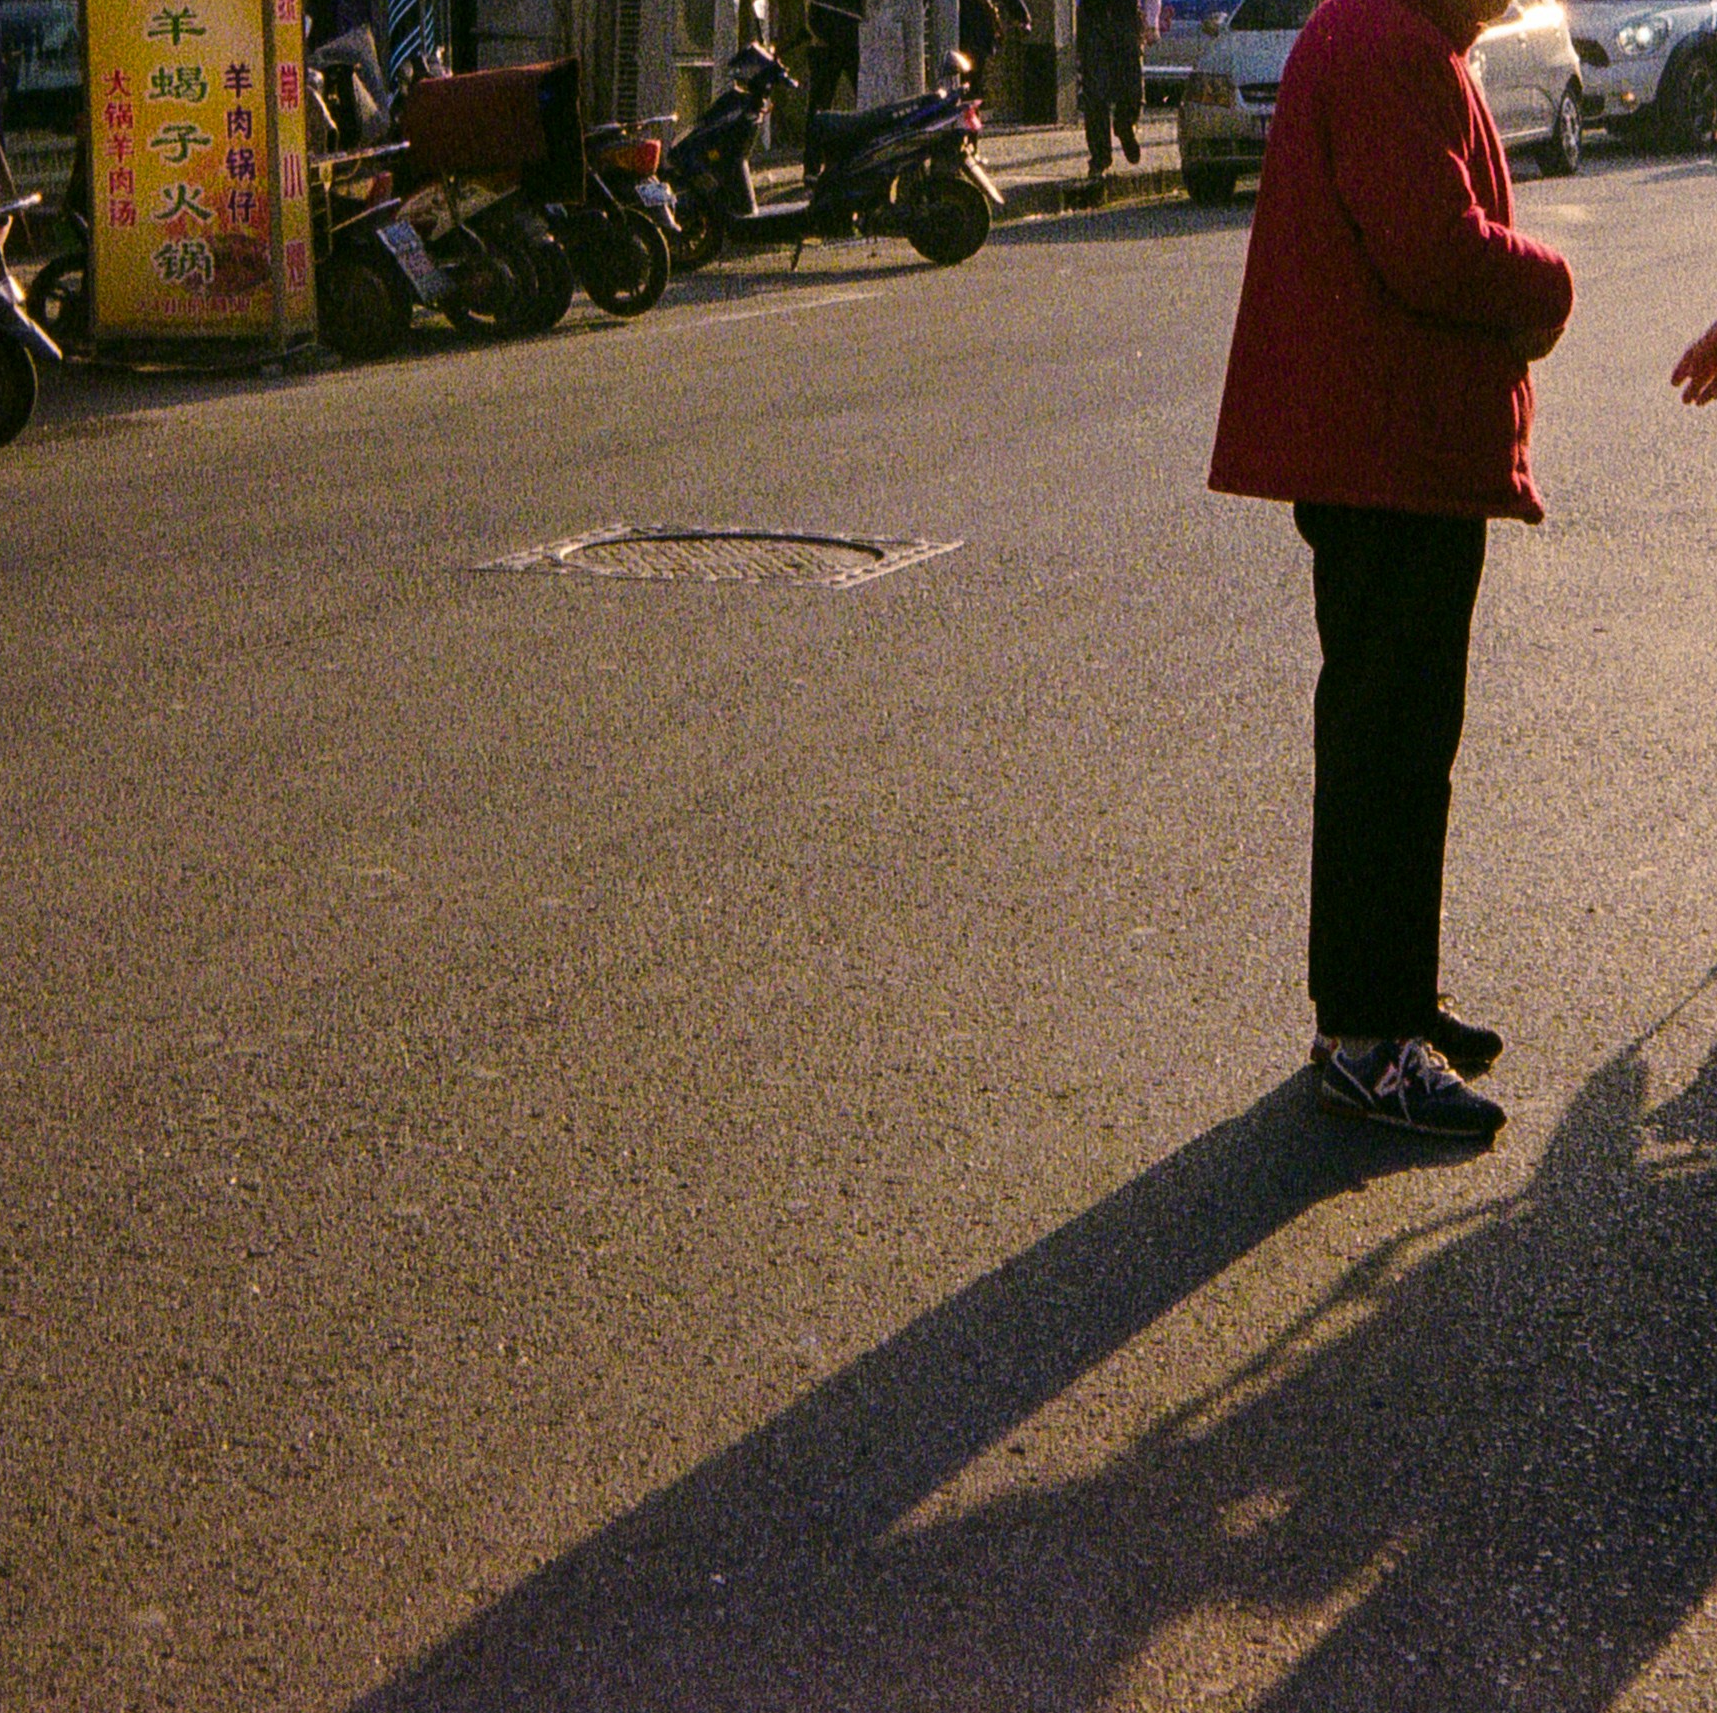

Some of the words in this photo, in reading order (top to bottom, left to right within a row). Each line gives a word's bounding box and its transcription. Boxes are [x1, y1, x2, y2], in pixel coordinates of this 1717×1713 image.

[100, 69, 137, 229] 大锅羊肉汤
[147, 6, 216, 286] 羊蝎子火锅
[222, 63, 258, 226] 羊肉锅仔
